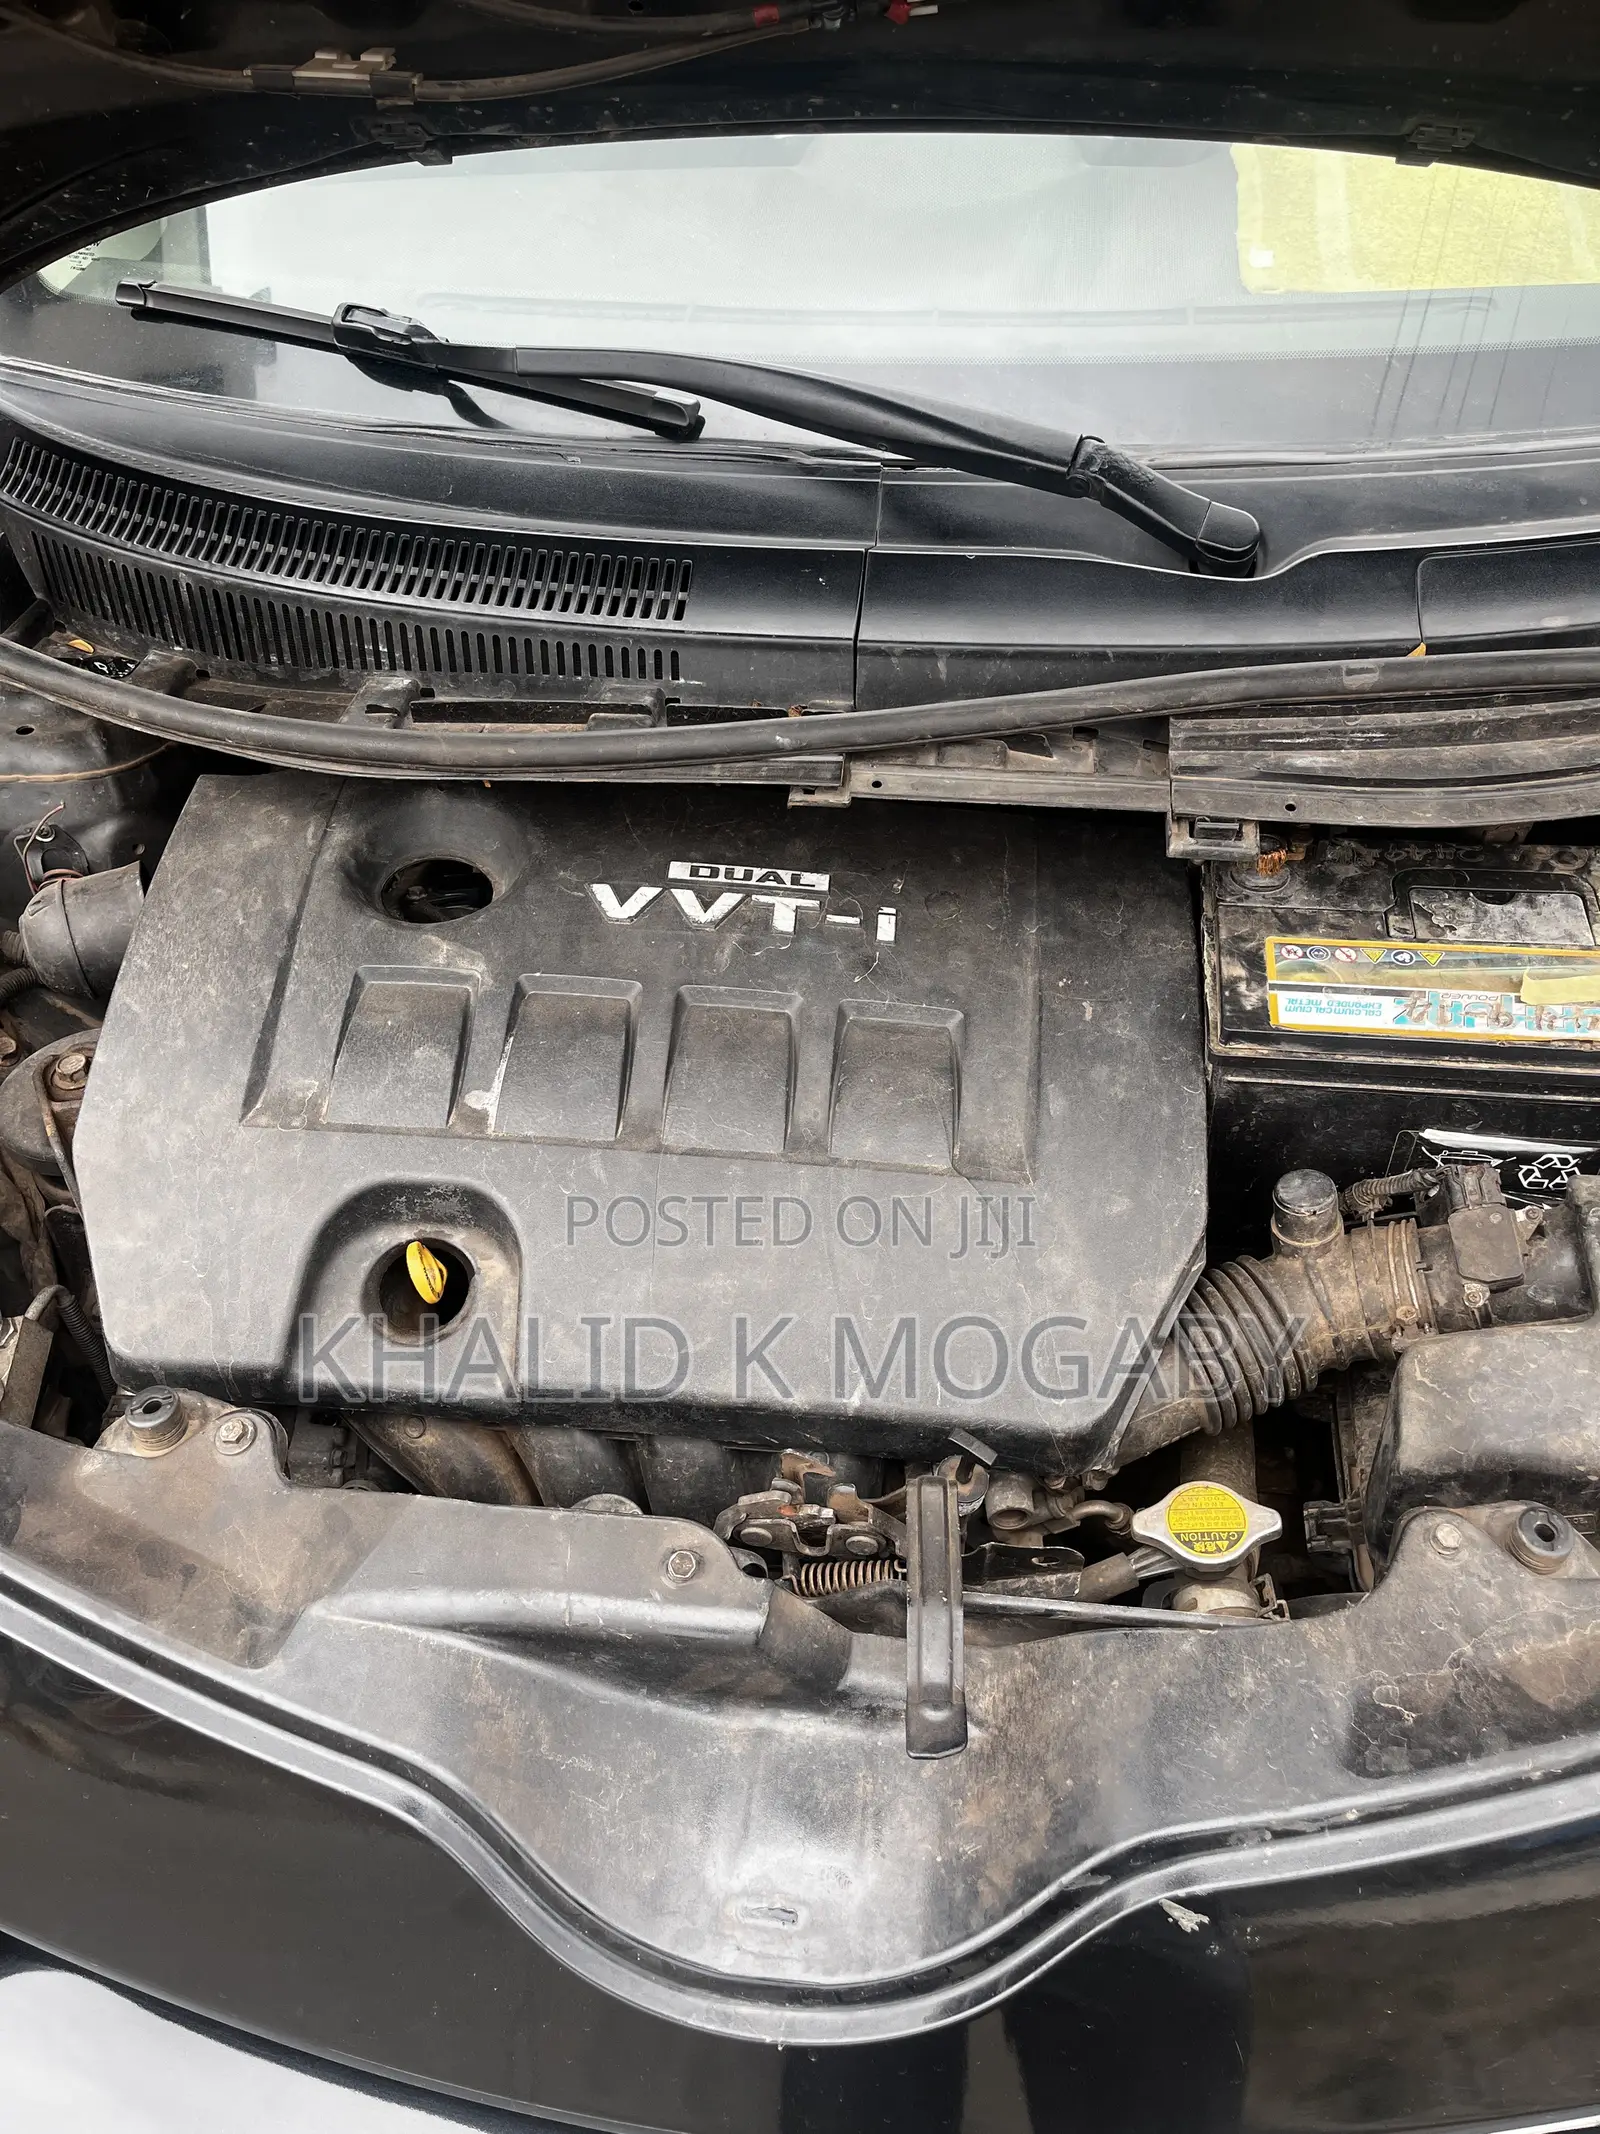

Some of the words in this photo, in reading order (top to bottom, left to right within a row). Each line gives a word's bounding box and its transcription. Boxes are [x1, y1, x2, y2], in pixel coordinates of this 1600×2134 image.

[688, 864, 817, 888] DUAL
[586, 882, 899, 946] VVT-i
[1441, 992, 1499, 1002] POWER
[1286, 998, 1322, 1008] METAL
[1327, 1000, 1382, 1010] EXPANDED
[1180, 1531, 1238, 1542] CAUTION
